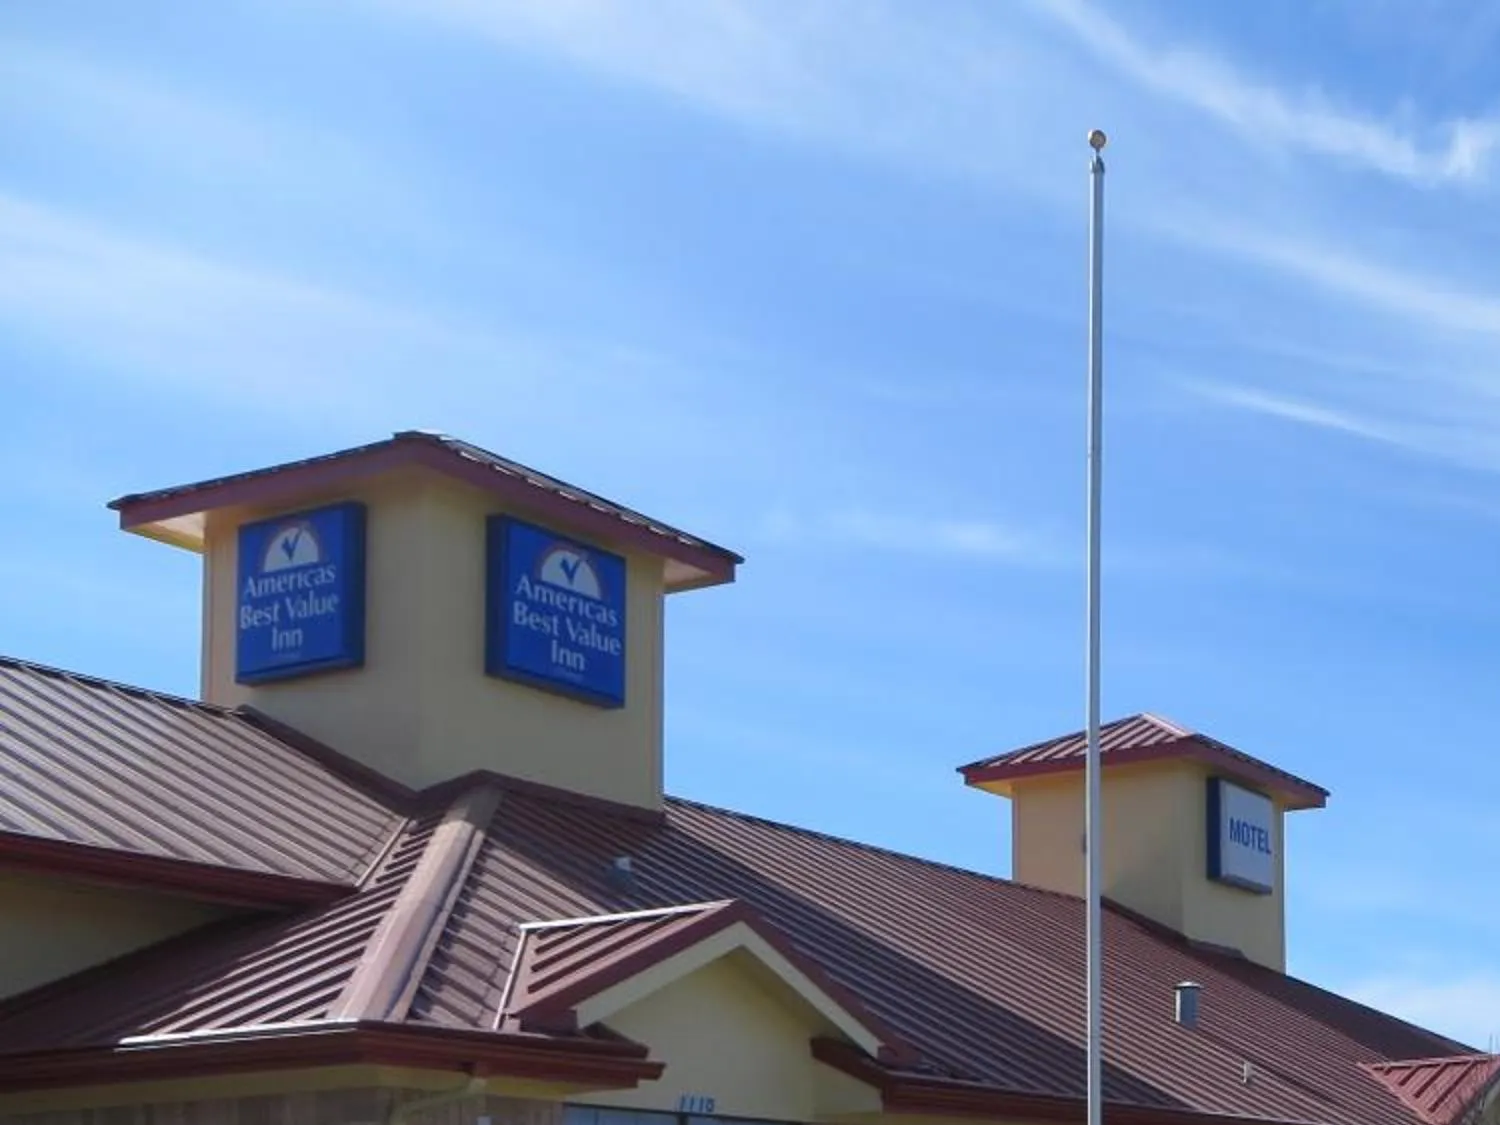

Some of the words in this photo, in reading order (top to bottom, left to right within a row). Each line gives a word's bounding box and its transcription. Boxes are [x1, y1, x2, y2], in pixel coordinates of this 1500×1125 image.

[243, 564, 337, 598] Americas
[514, 574, 619, 627] Americas
[240, 600, 279, 630] Best
[285, 590, 340, 620] Value
[513, 600, 560, 637] Best
[565, 616, 622, 656] Value
[271, 627, 303, 652] Inn
[551, 639, 586, 672] Inn
[1229, 816, 1272, 855] MOTEL
